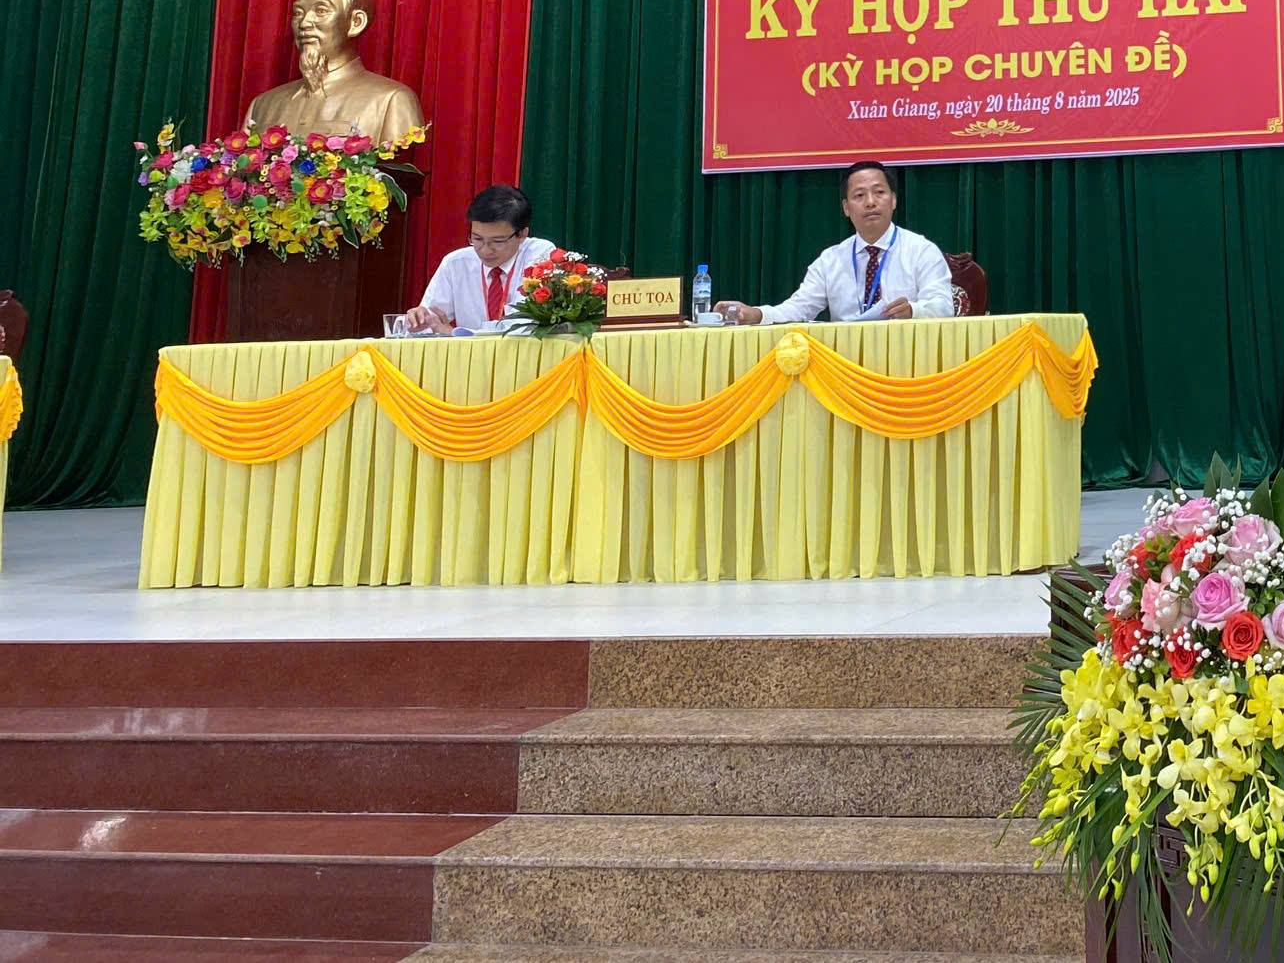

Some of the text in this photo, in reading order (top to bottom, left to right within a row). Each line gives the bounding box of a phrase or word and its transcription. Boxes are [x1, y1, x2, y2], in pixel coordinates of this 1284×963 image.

[801, 31, 1188, 96] (KỲ HỌP CHUYÊN ĐỀ)
[847, 86, 1140, 120] Xuân Giang, ngày 20 tháng 8 năm 2025
[612, 288, 674, 306] CHỦ TỌA
